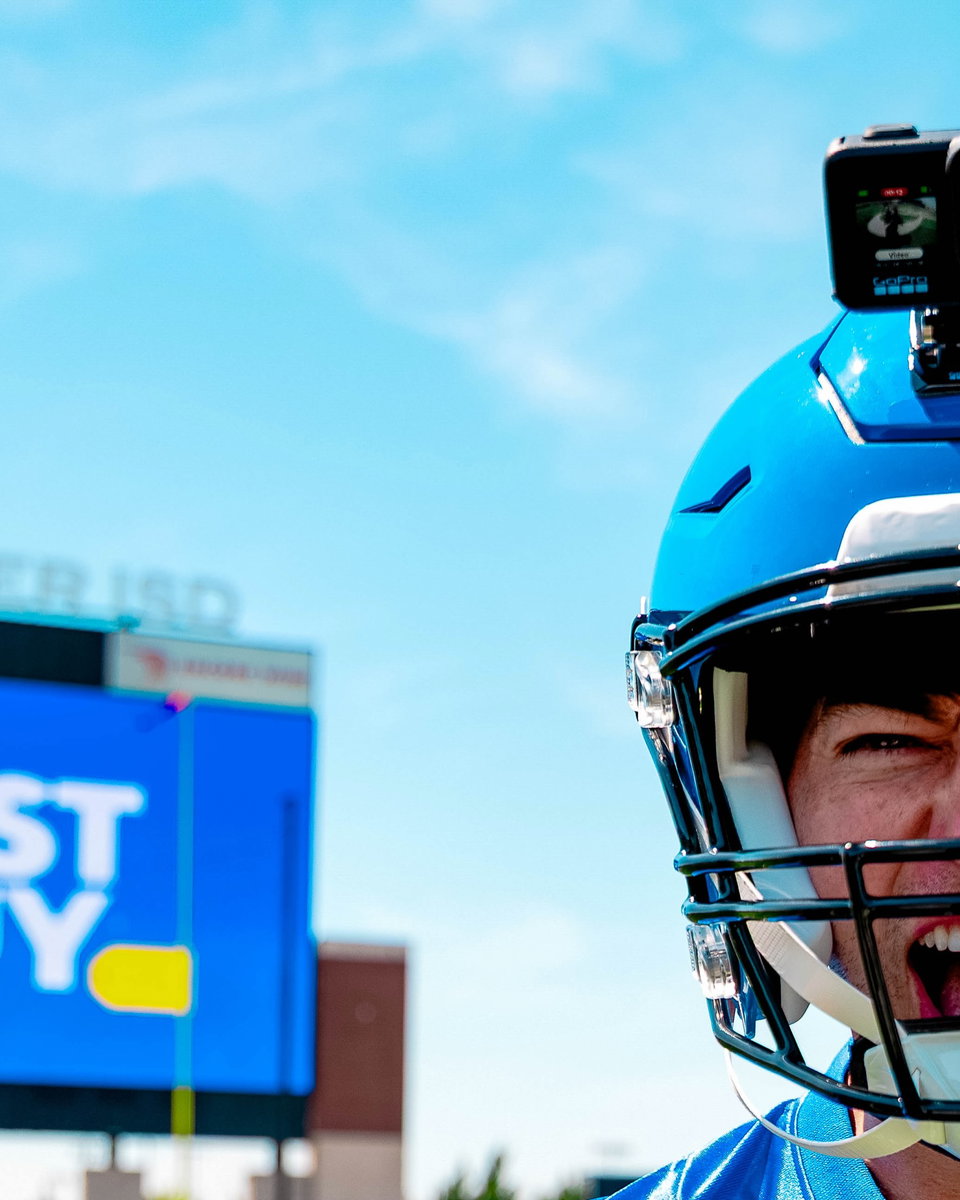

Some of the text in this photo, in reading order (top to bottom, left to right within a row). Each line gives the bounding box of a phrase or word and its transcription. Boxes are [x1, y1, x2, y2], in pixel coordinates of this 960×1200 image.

[873, 275, 928, 287] GoPro
[109, 566, 241, 635] ISD
[0, 773, 144, 880] ST
[0, 885, 109, 991] Y
